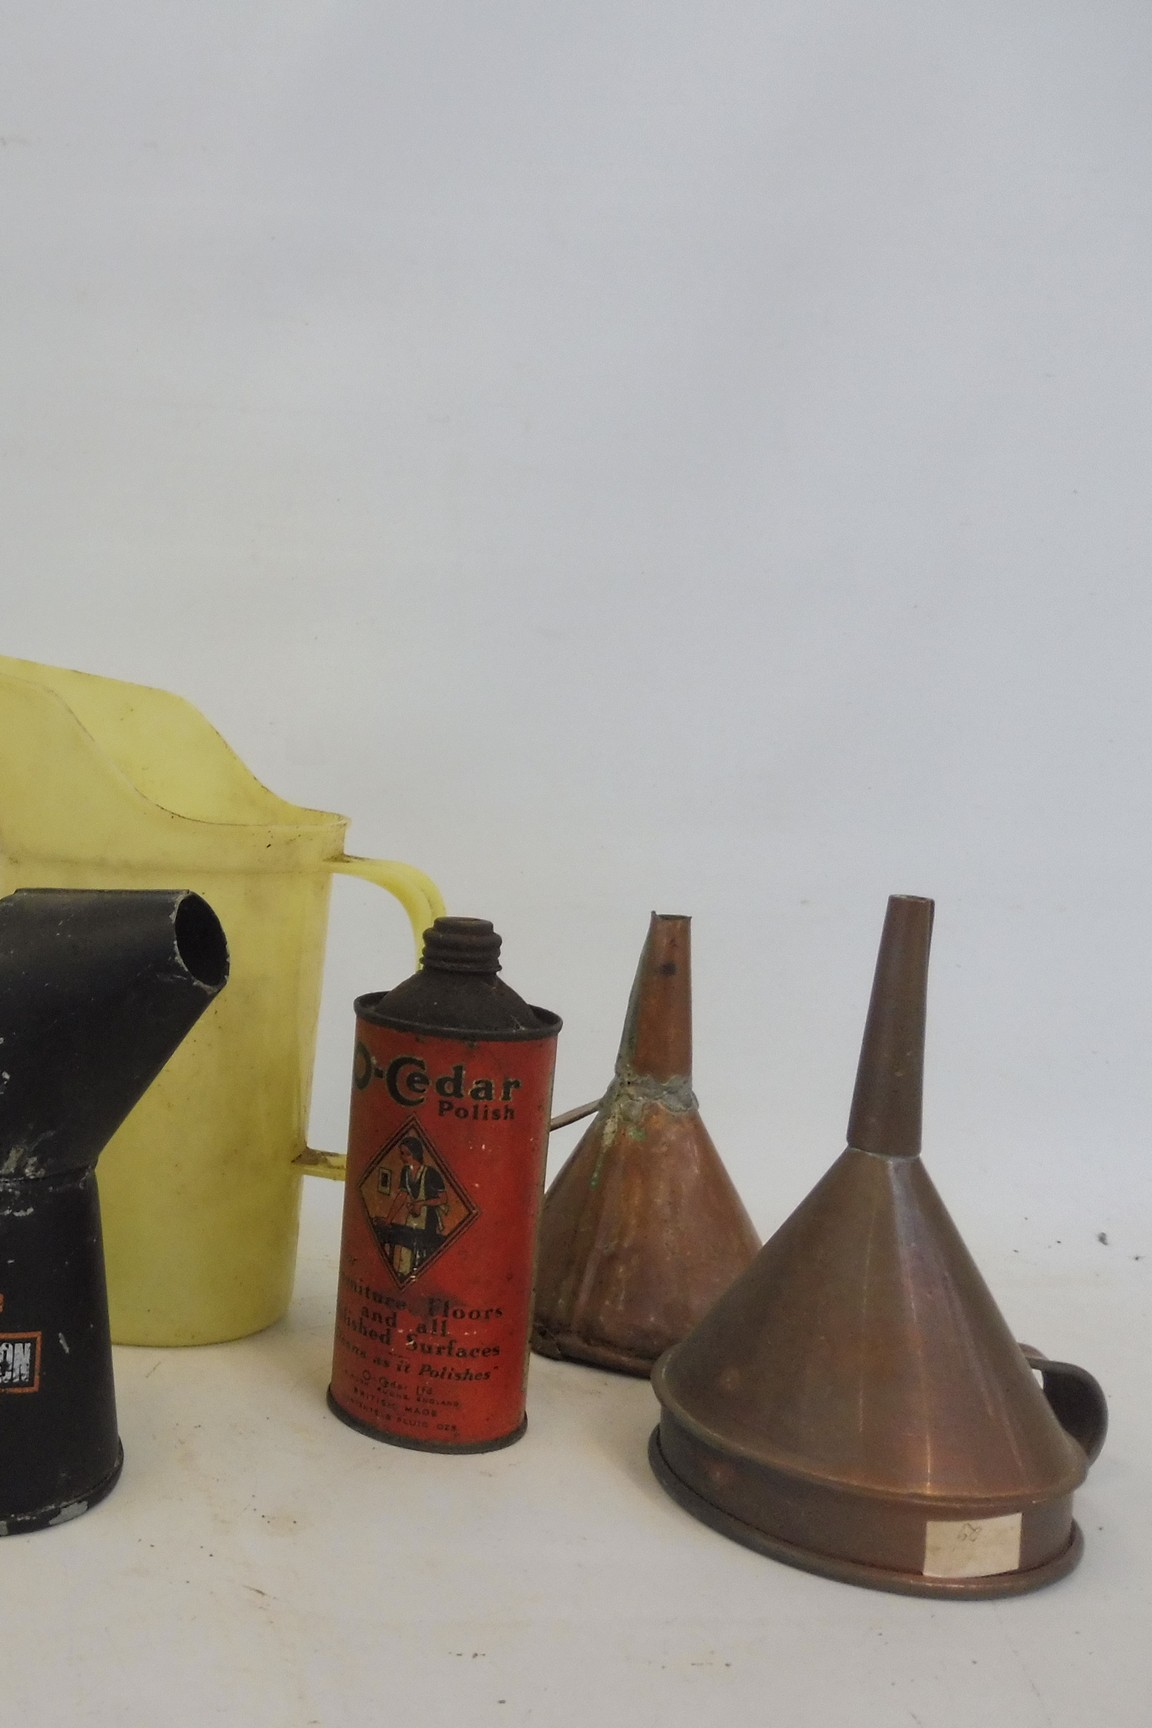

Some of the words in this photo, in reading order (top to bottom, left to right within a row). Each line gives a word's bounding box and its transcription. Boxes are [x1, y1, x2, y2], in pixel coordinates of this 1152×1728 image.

[438, 1100, 516, 1121] Polish
[361, 1306, 397, 1328] and
[416, 1319, 448, 1337] all
[428, 1297, 504, 1322] Floors
[406, 1333, 501, 1358] Surfaces
